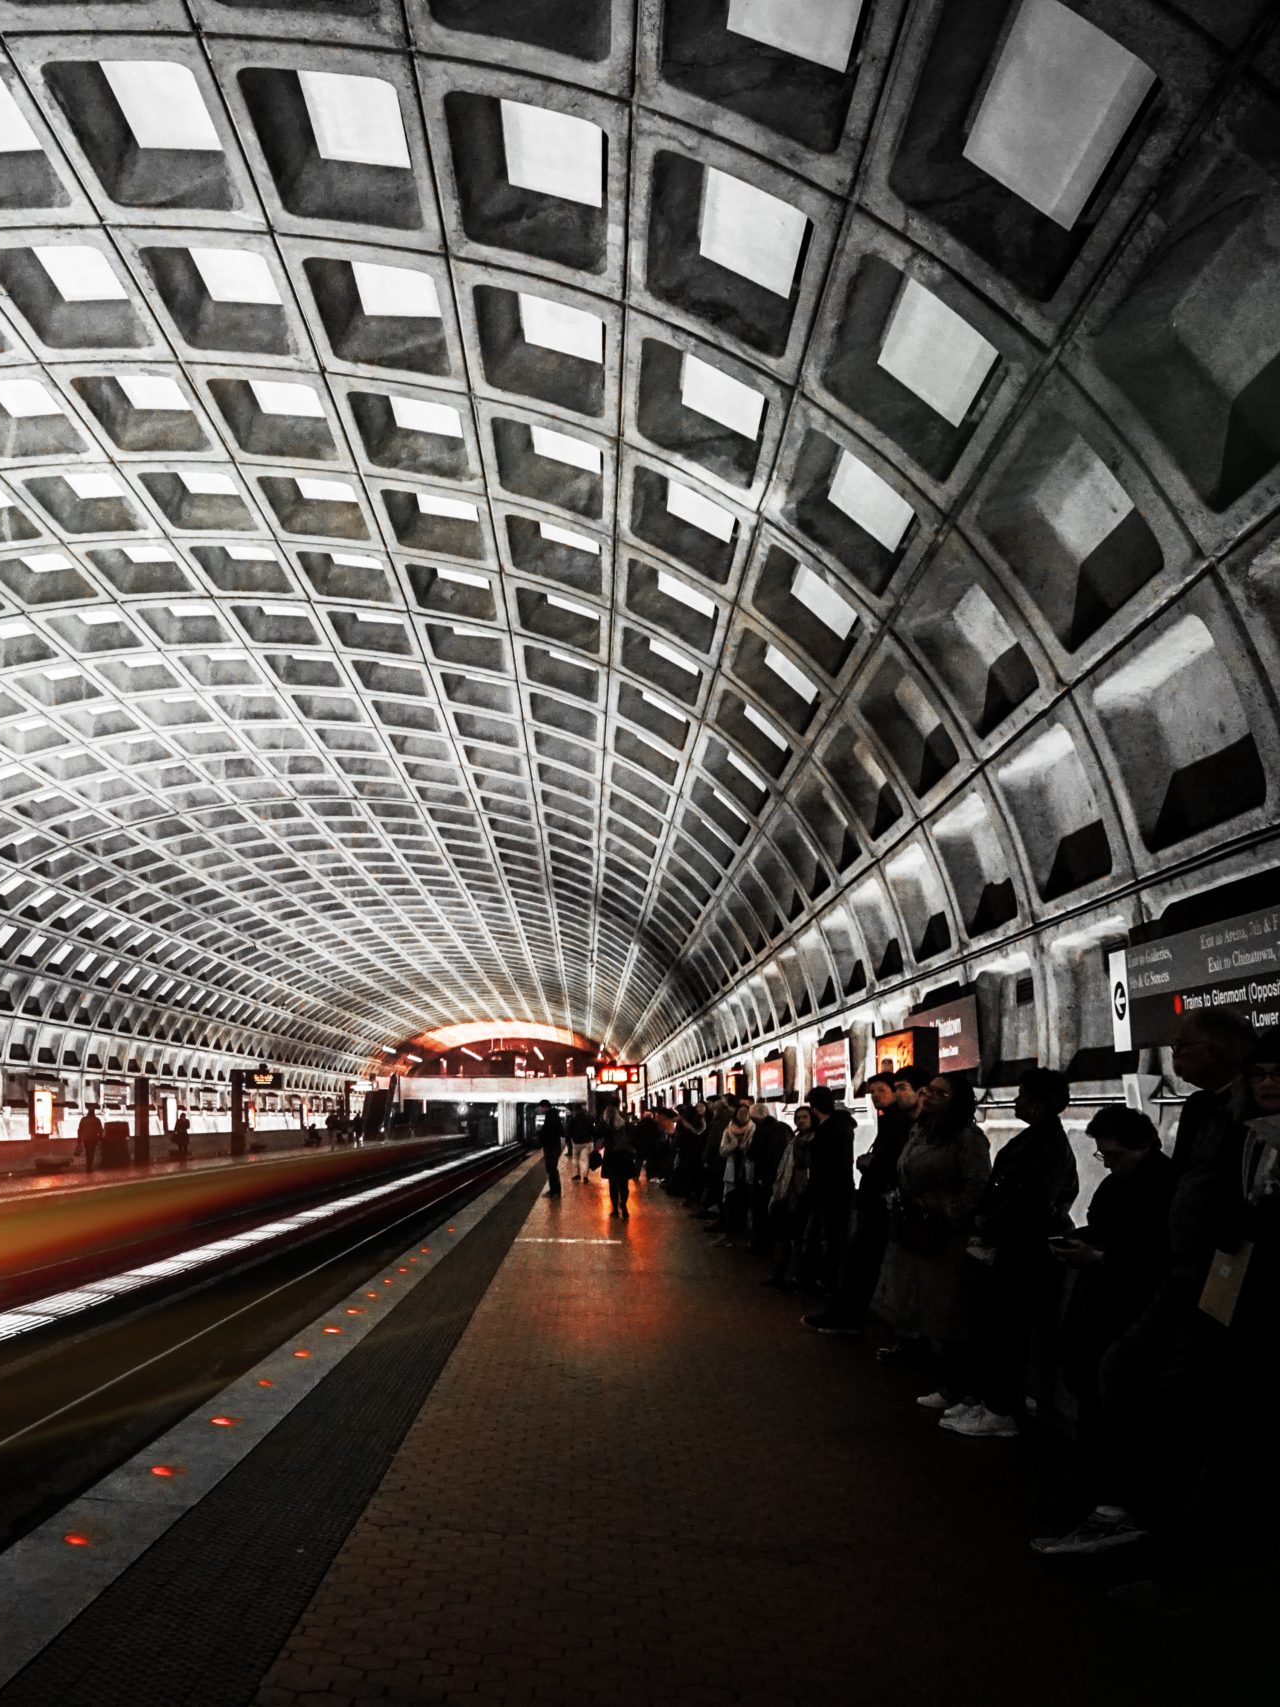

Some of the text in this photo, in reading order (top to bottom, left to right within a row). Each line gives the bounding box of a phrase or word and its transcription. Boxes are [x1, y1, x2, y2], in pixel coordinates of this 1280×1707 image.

[1182, 993, 1203, 1010] Trains
[1204, 991, 1211, 1006] to
[1212, 985, 1247, 1006] Glenmont
